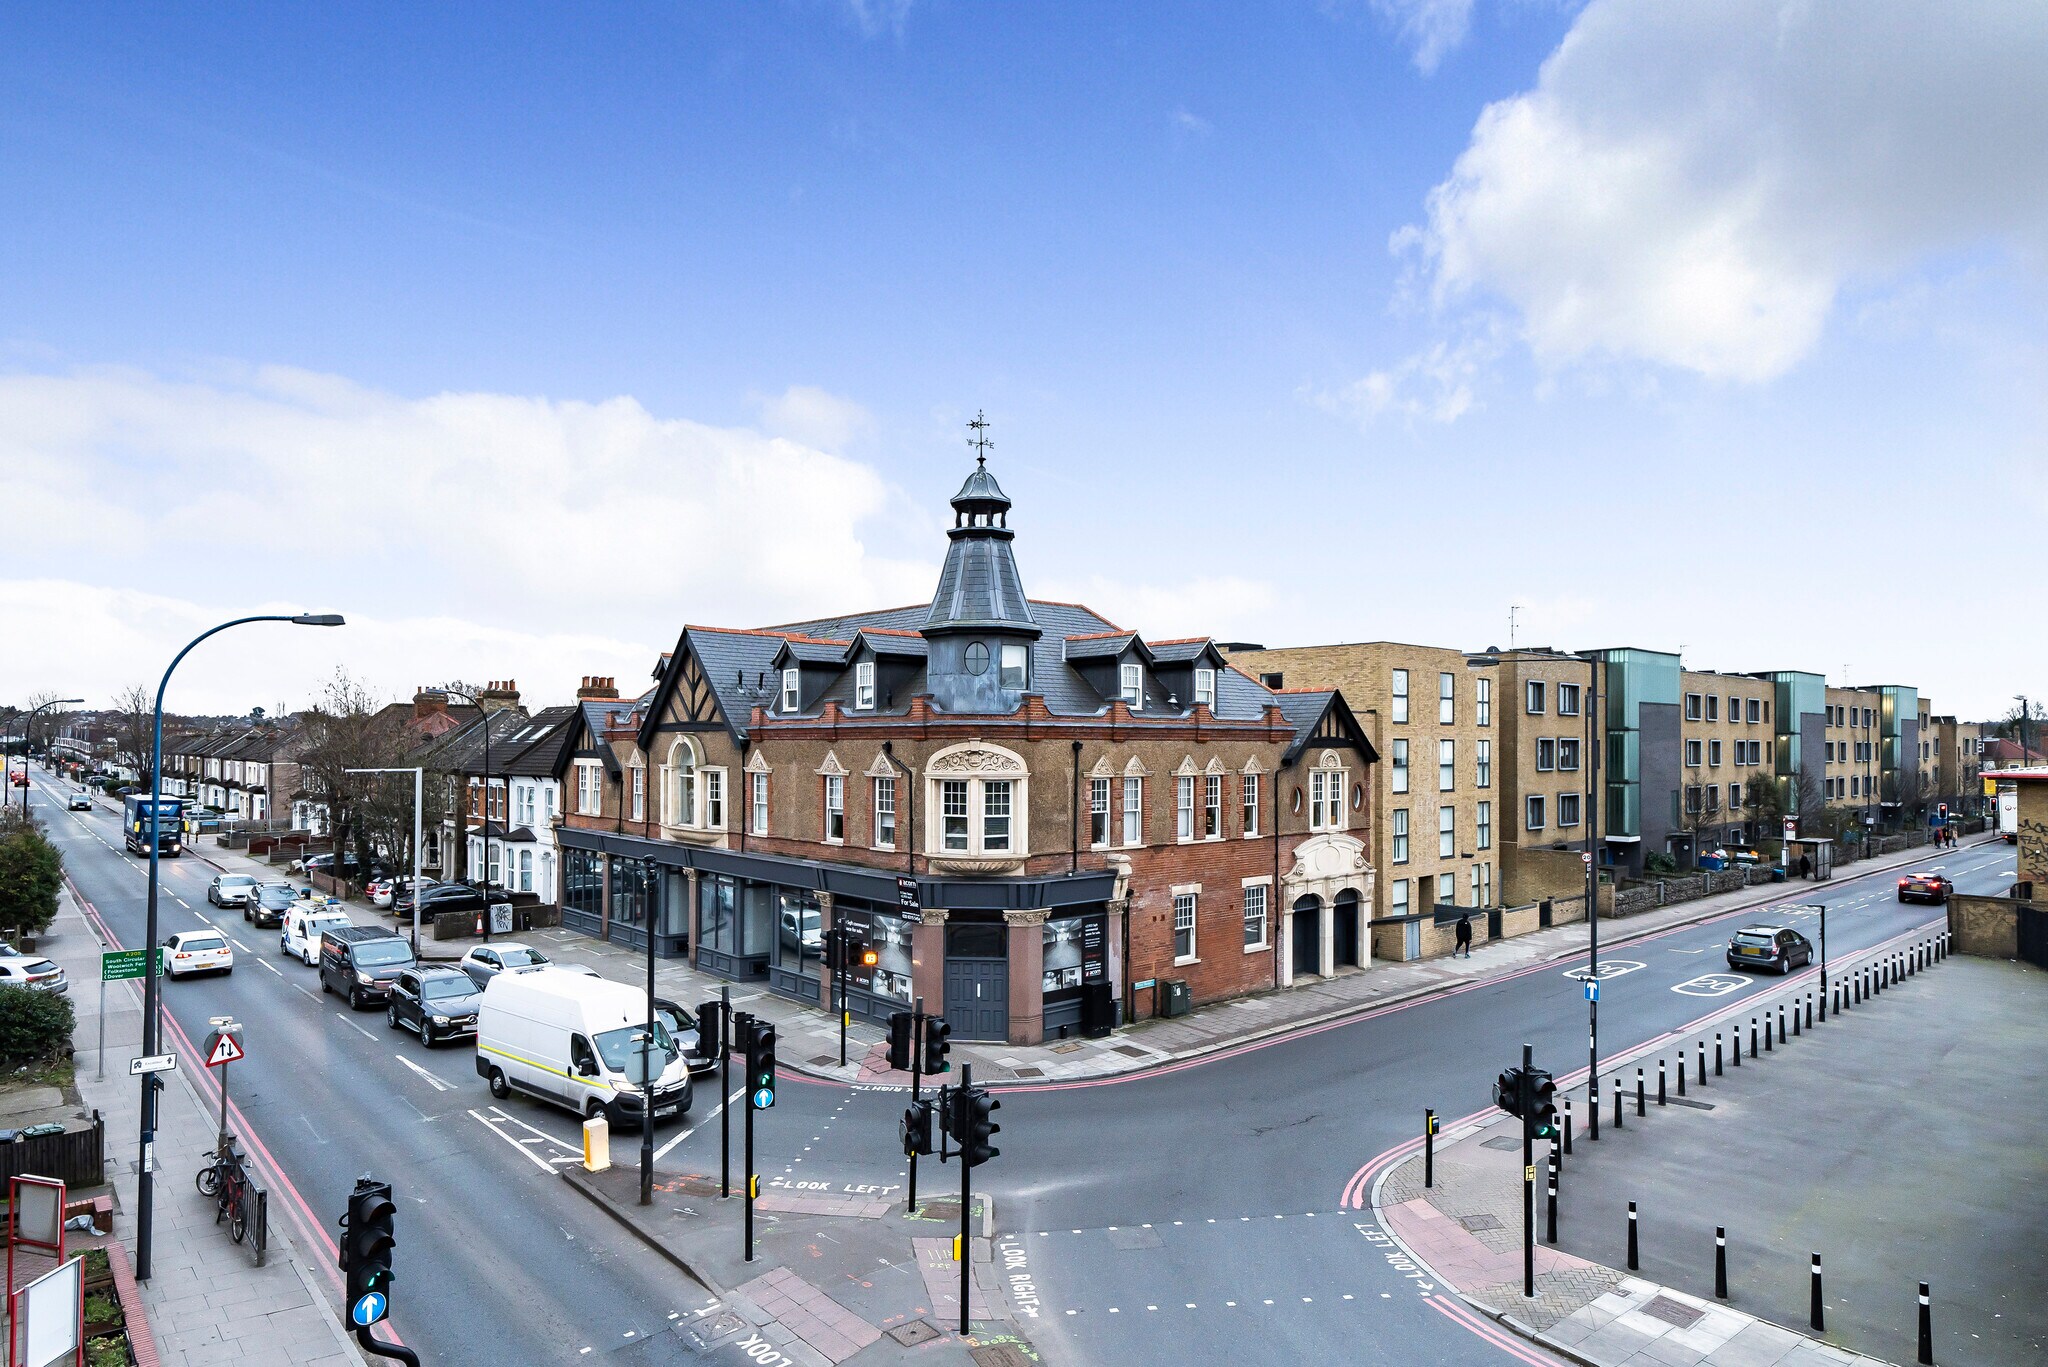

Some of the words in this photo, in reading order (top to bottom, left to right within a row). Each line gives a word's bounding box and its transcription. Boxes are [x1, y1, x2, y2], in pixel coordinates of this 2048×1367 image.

[1688, 978, 1737, 990] 20
[784, 1180, 831, 1190] LOOK
[844, 1184, 895, 1195] LEFT
[1354, 1223, 1395, 1248] LEFT
[1000, 1242, 1027, 1270] LOOK
[1384, 1252, 1425, 1278] LOOK
[1009, 1274, 1040, 1306] RIGHT
[736, 1334, 793, 1367] LOOK
